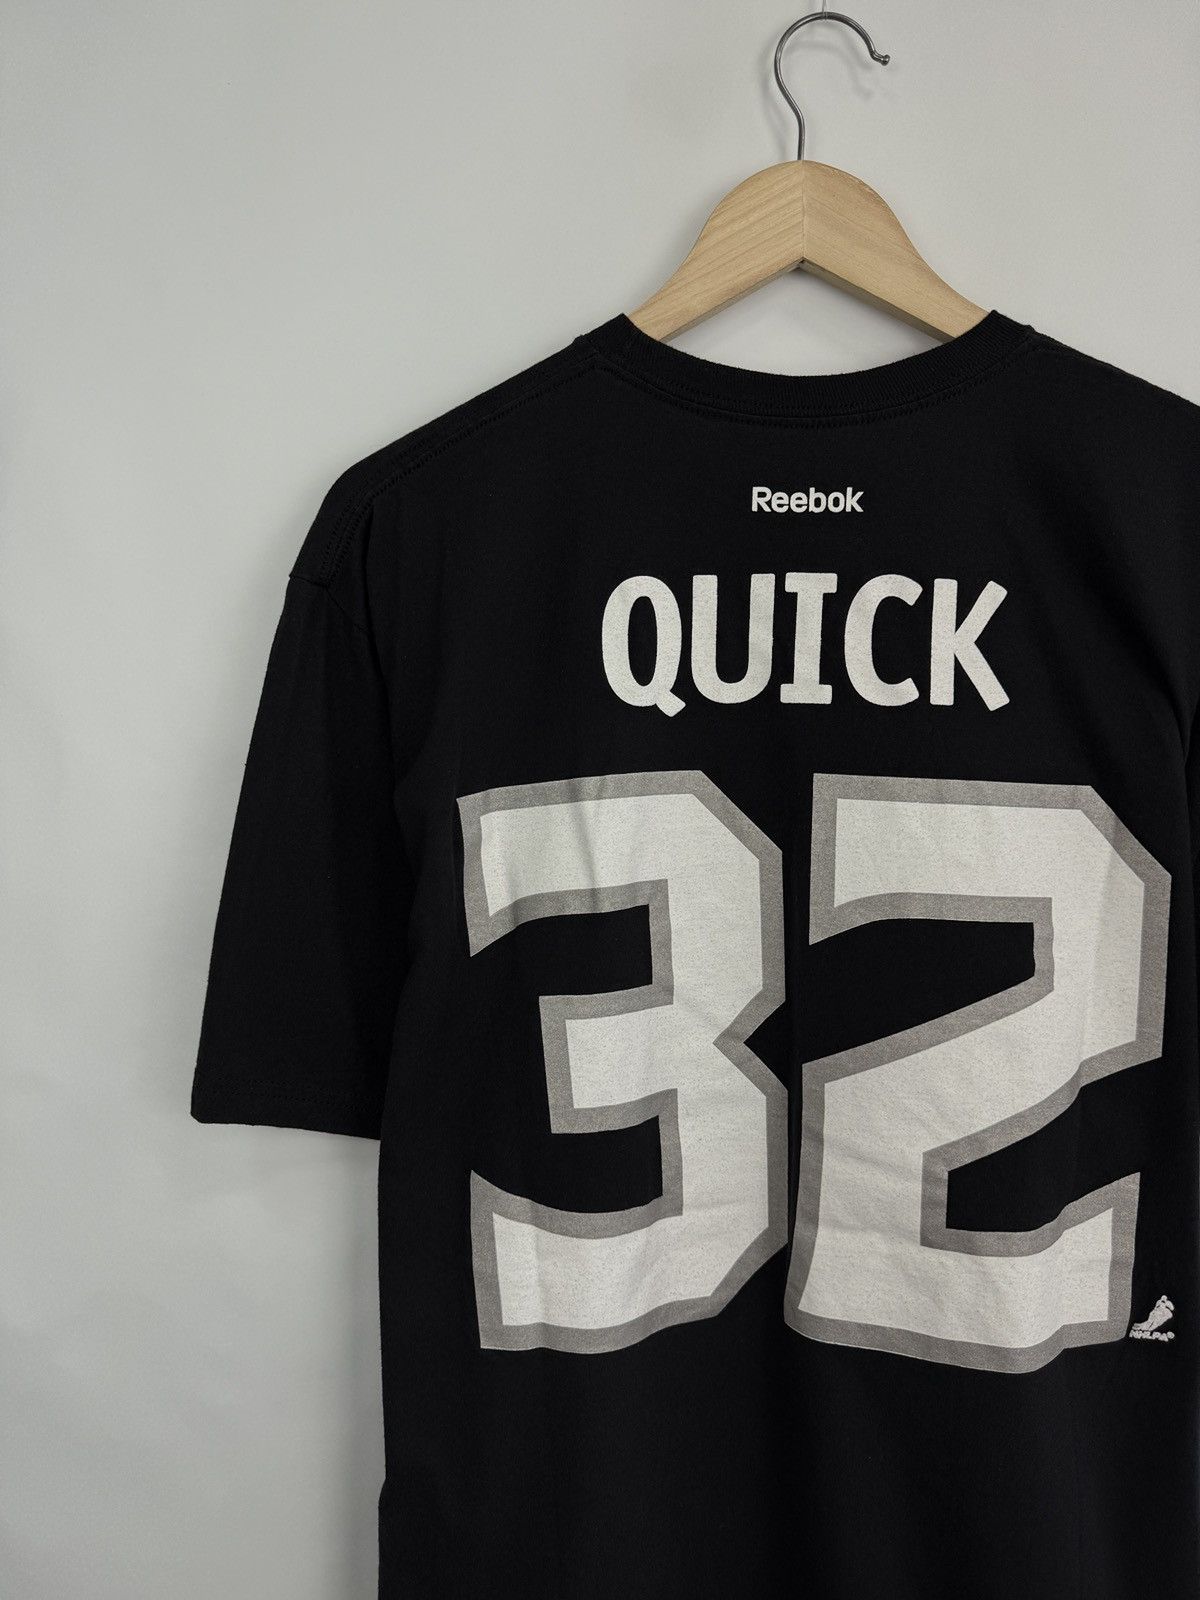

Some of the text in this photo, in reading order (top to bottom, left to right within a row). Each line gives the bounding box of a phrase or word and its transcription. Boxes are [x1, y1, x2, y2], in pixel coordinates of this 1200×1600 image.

[751, 486, 865, 513] Reebok
[601, 571, 1011, 718] QUICK
[457, 769, 1172, 1375] 32
